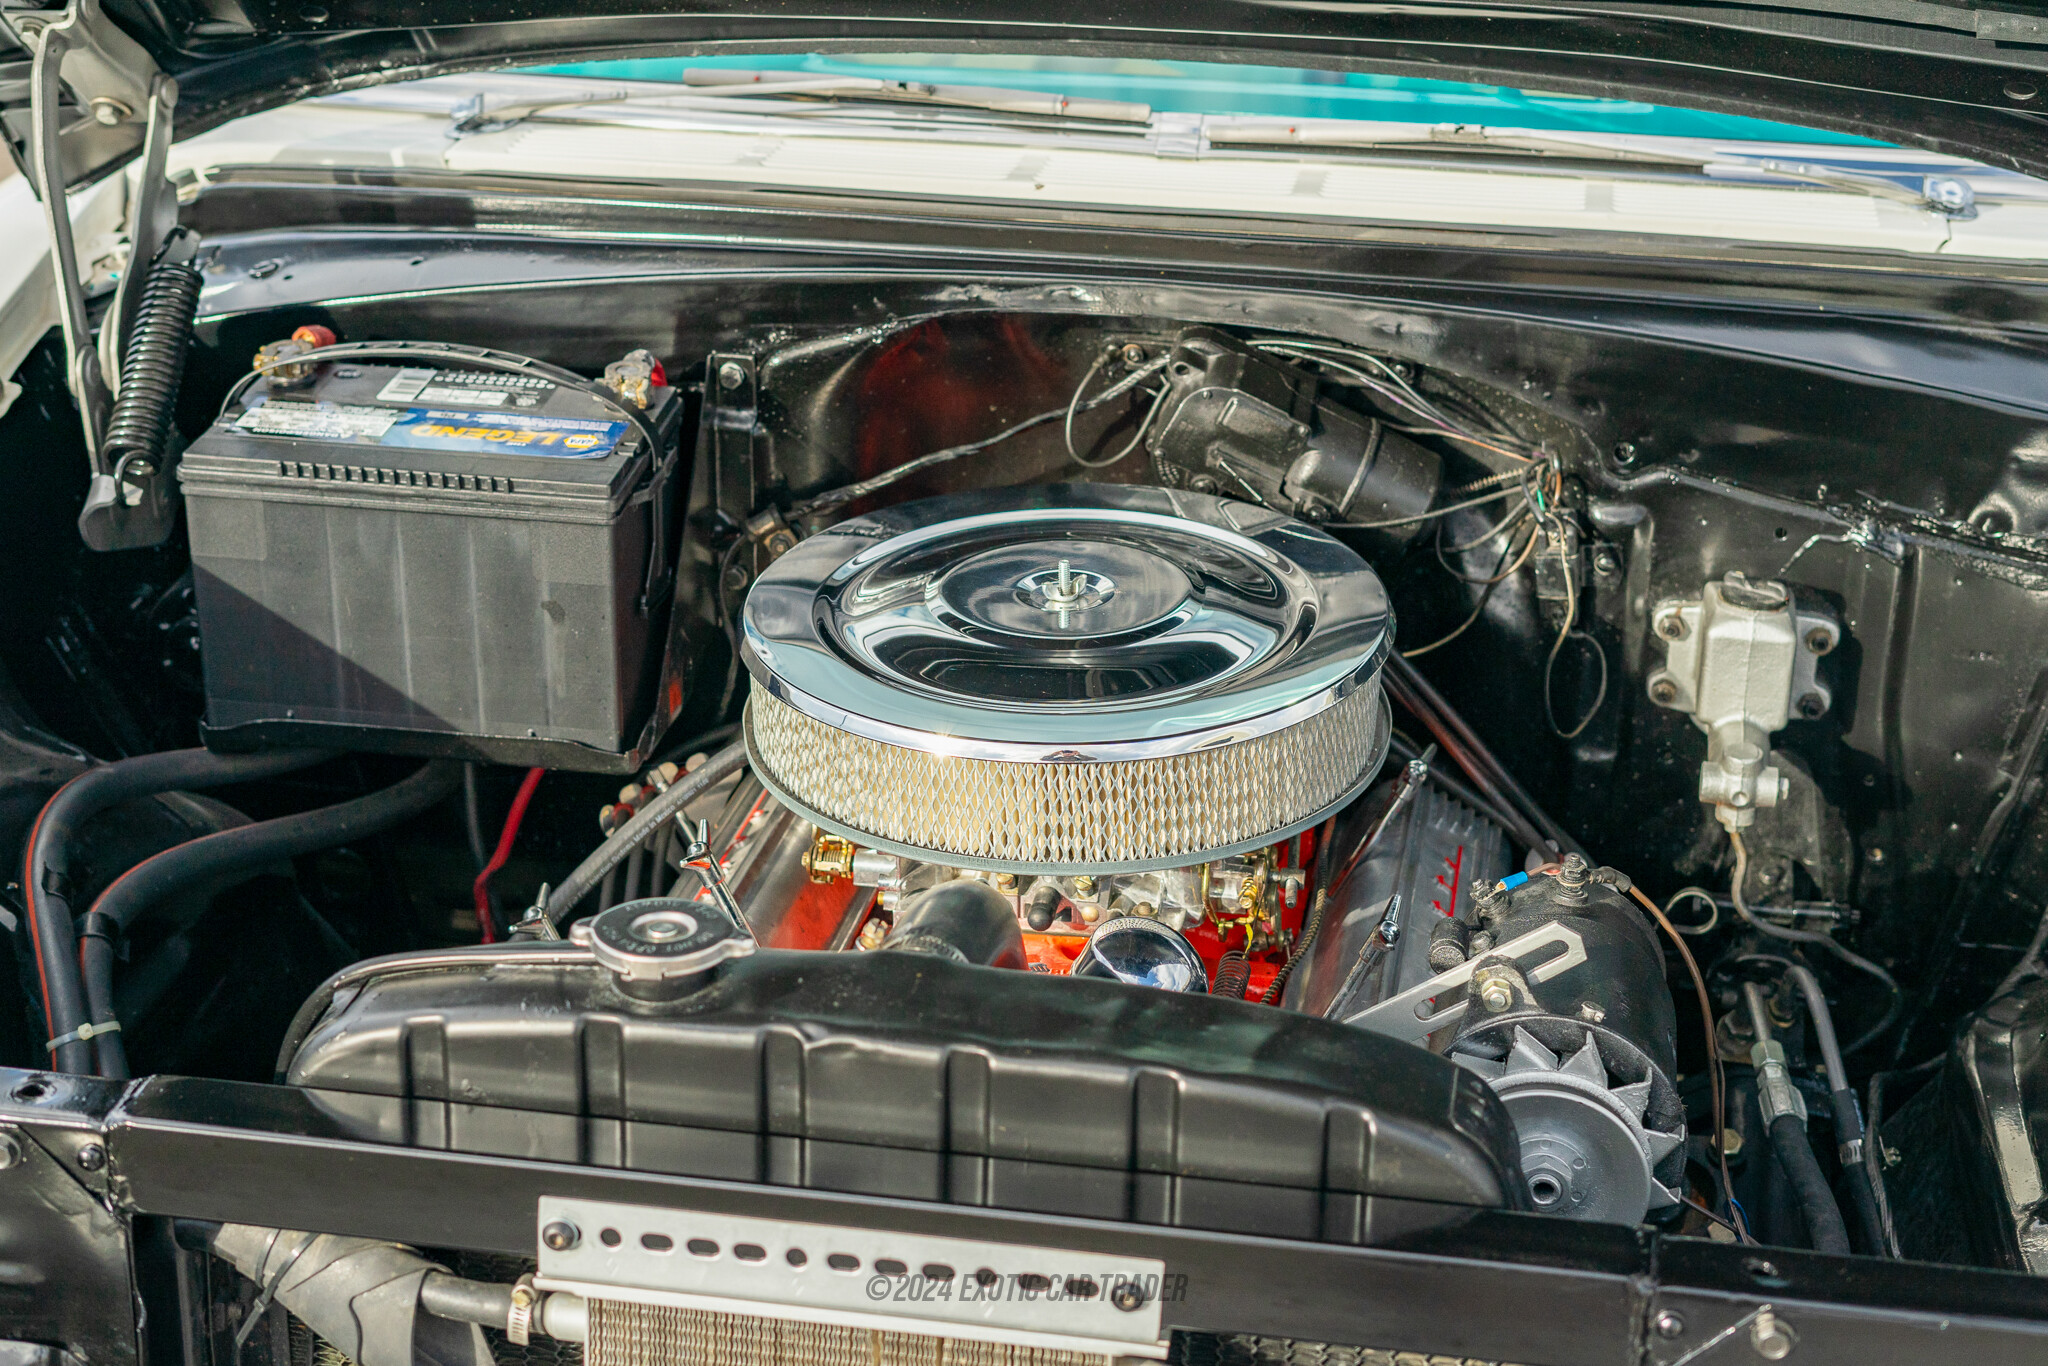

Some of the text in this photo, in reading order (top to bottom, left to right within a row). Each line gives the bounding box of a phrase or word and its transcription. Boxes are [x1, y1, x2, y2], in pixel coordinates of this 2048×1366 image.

[410, 424, 562, 446] LEGEND
[588, 863, 613, 886] Injection
[611, 841, 635, 863] Systems
[633, 827, 650, 843] Made
[655, 805, 676, 823] Mexico
